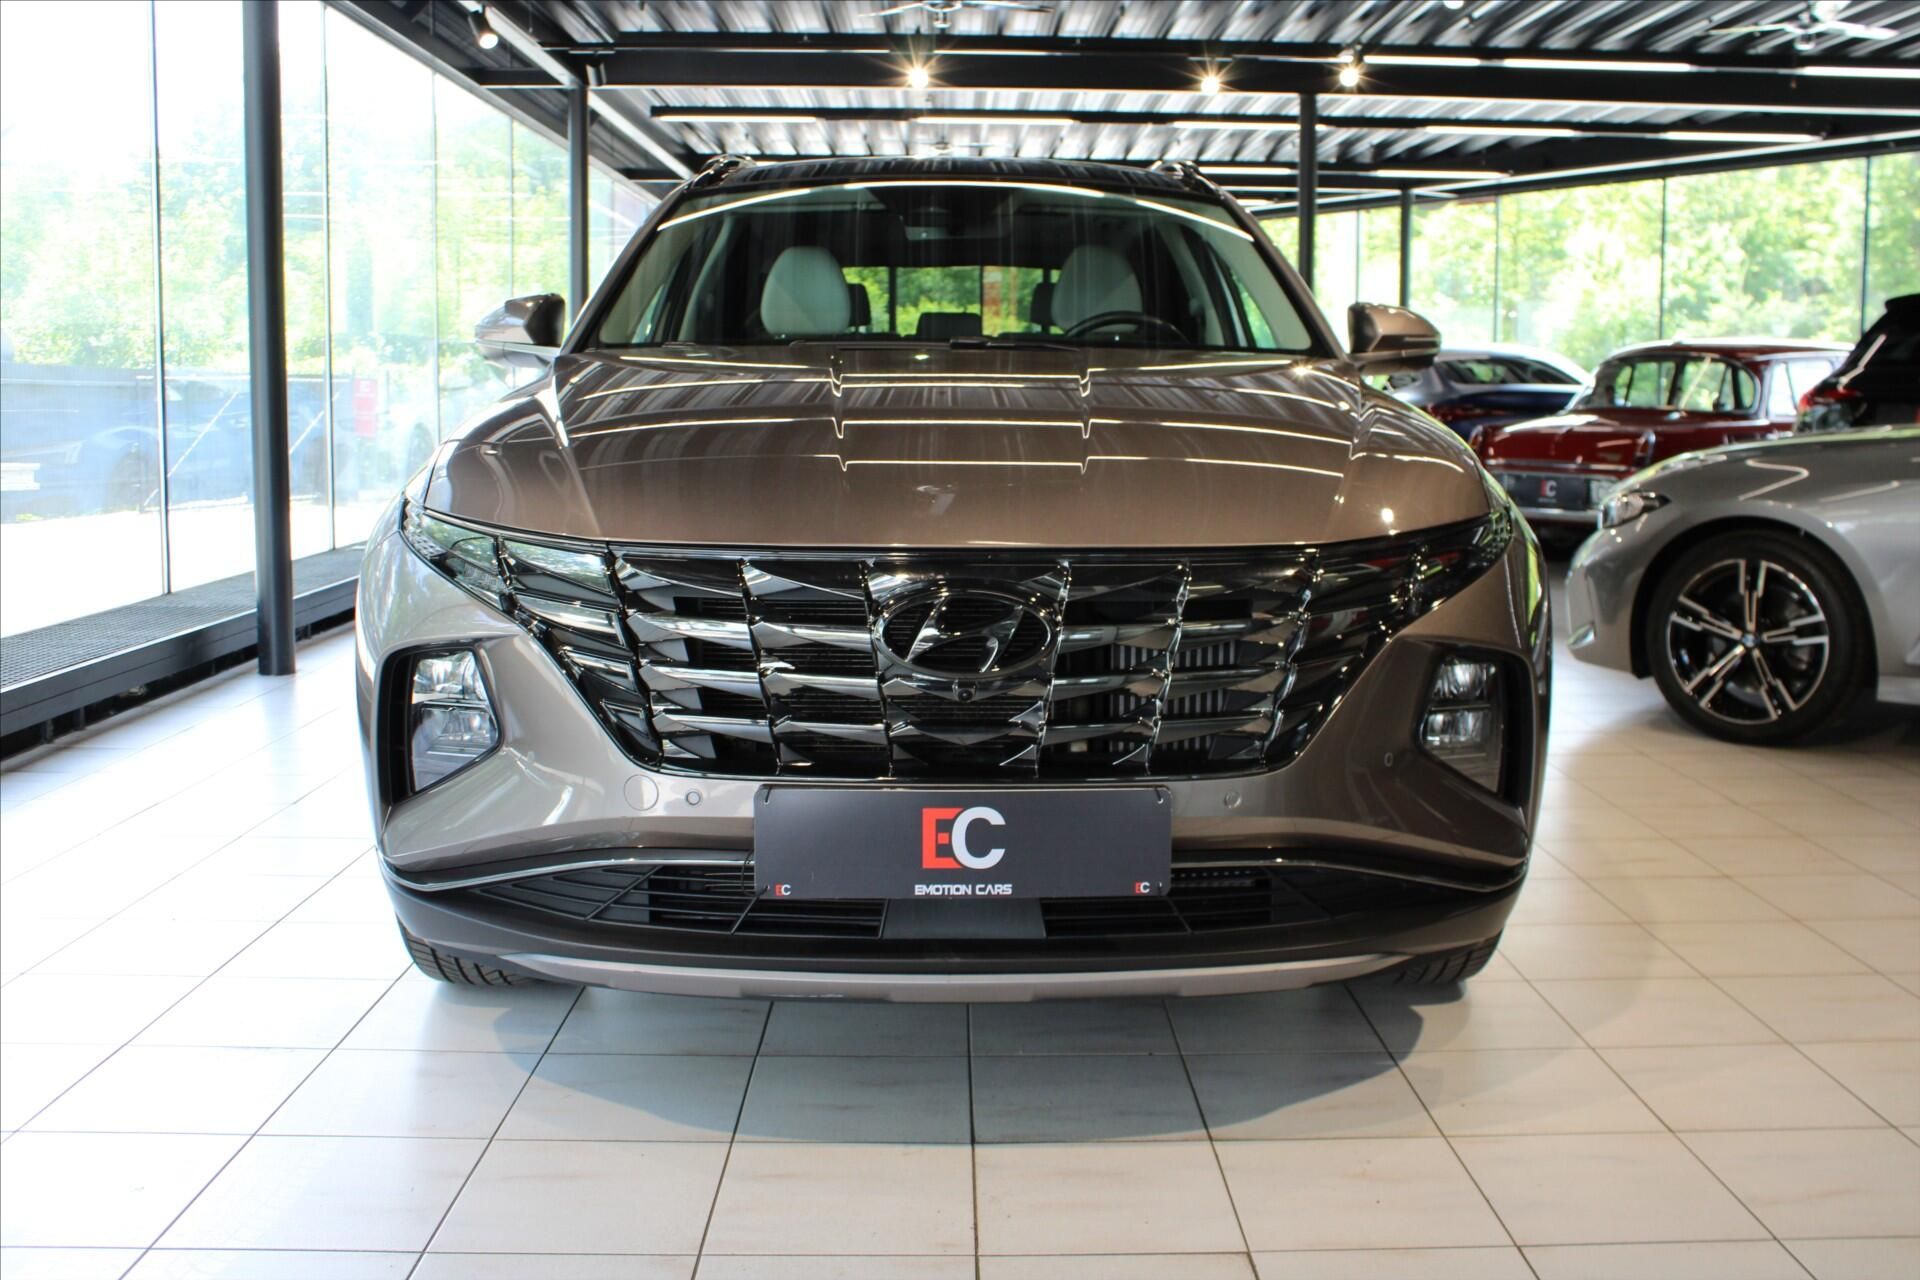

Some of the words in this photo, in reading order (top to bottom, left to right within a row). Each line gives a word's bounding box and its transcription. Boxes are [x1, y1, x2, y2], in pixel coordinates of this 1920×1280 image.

[922, 806, 1006, 869] EC
[775, 884, 791, 896] EC
[914, 884, 972, 895] EMOTION
[975, 884, 1013, 895] CARS
[1135, 881, 1150, 893] EC
